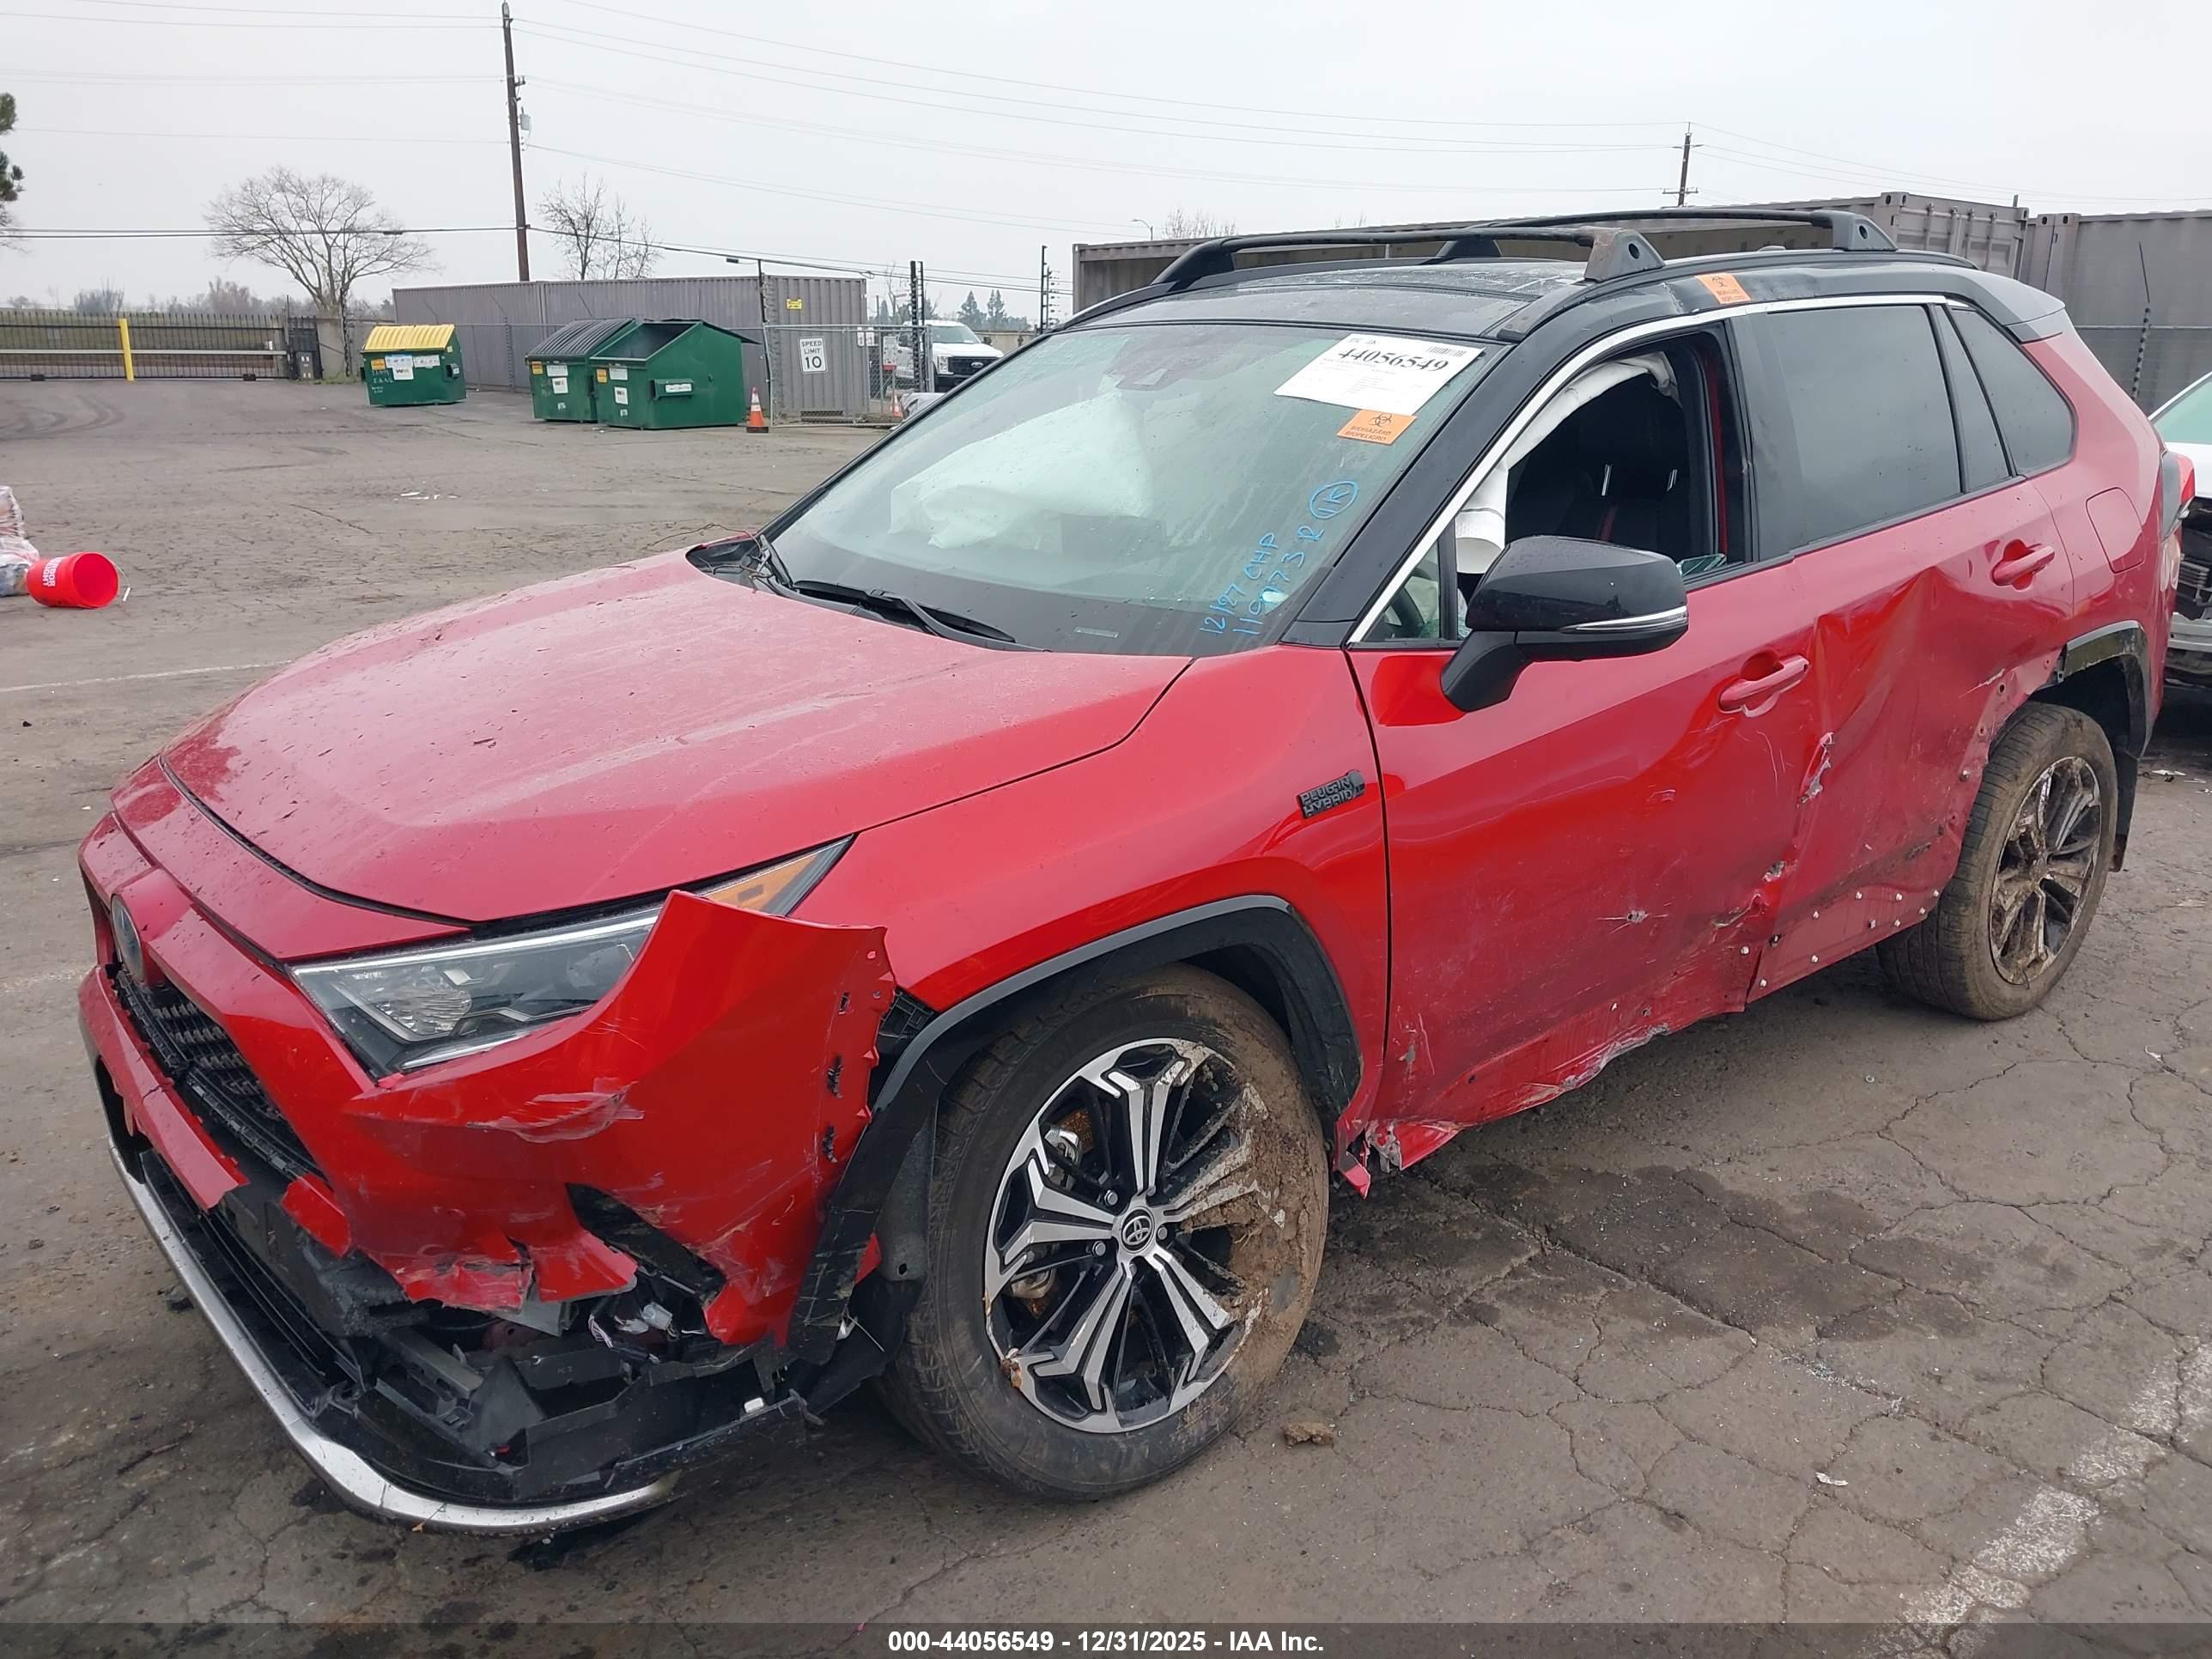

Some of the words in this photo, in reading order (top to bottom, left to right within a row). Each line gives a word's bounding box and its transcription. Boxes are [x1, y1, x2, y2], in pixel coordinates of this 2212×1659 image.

[805, 356, 822, 369] 10
[1338, 347, 1449, 372] 44056549
[1351, 426, 1392, 436] BIOHAZARD
[1199, 582, 1247, 635] 12/27
[1243, 532, 1279, 580] CHP
[1303, 789, 1352, 817] HYBRID
